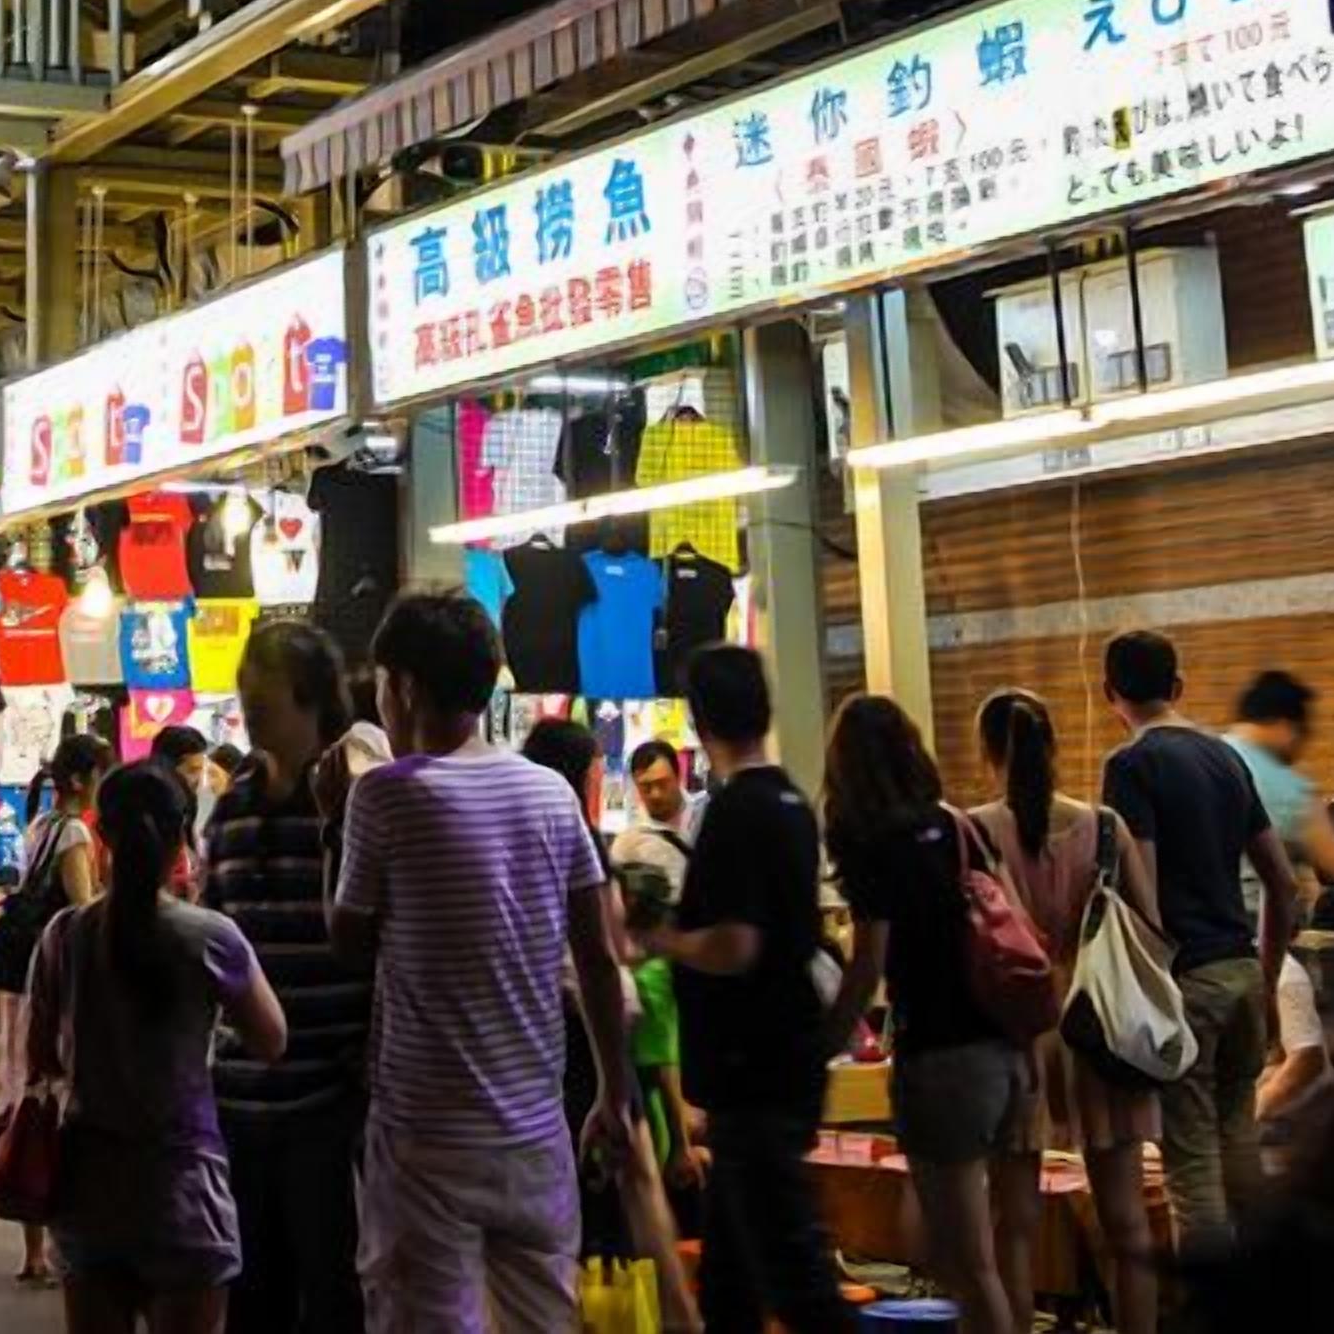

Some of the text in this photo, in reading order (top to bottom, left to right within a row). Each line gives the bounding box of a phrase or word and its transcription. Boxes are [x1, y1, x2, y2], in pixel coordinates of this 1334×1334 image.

[731, 26, 1029, 169] 迷你釣蝦
[409, 158, 652, 305] 高級撈魚
